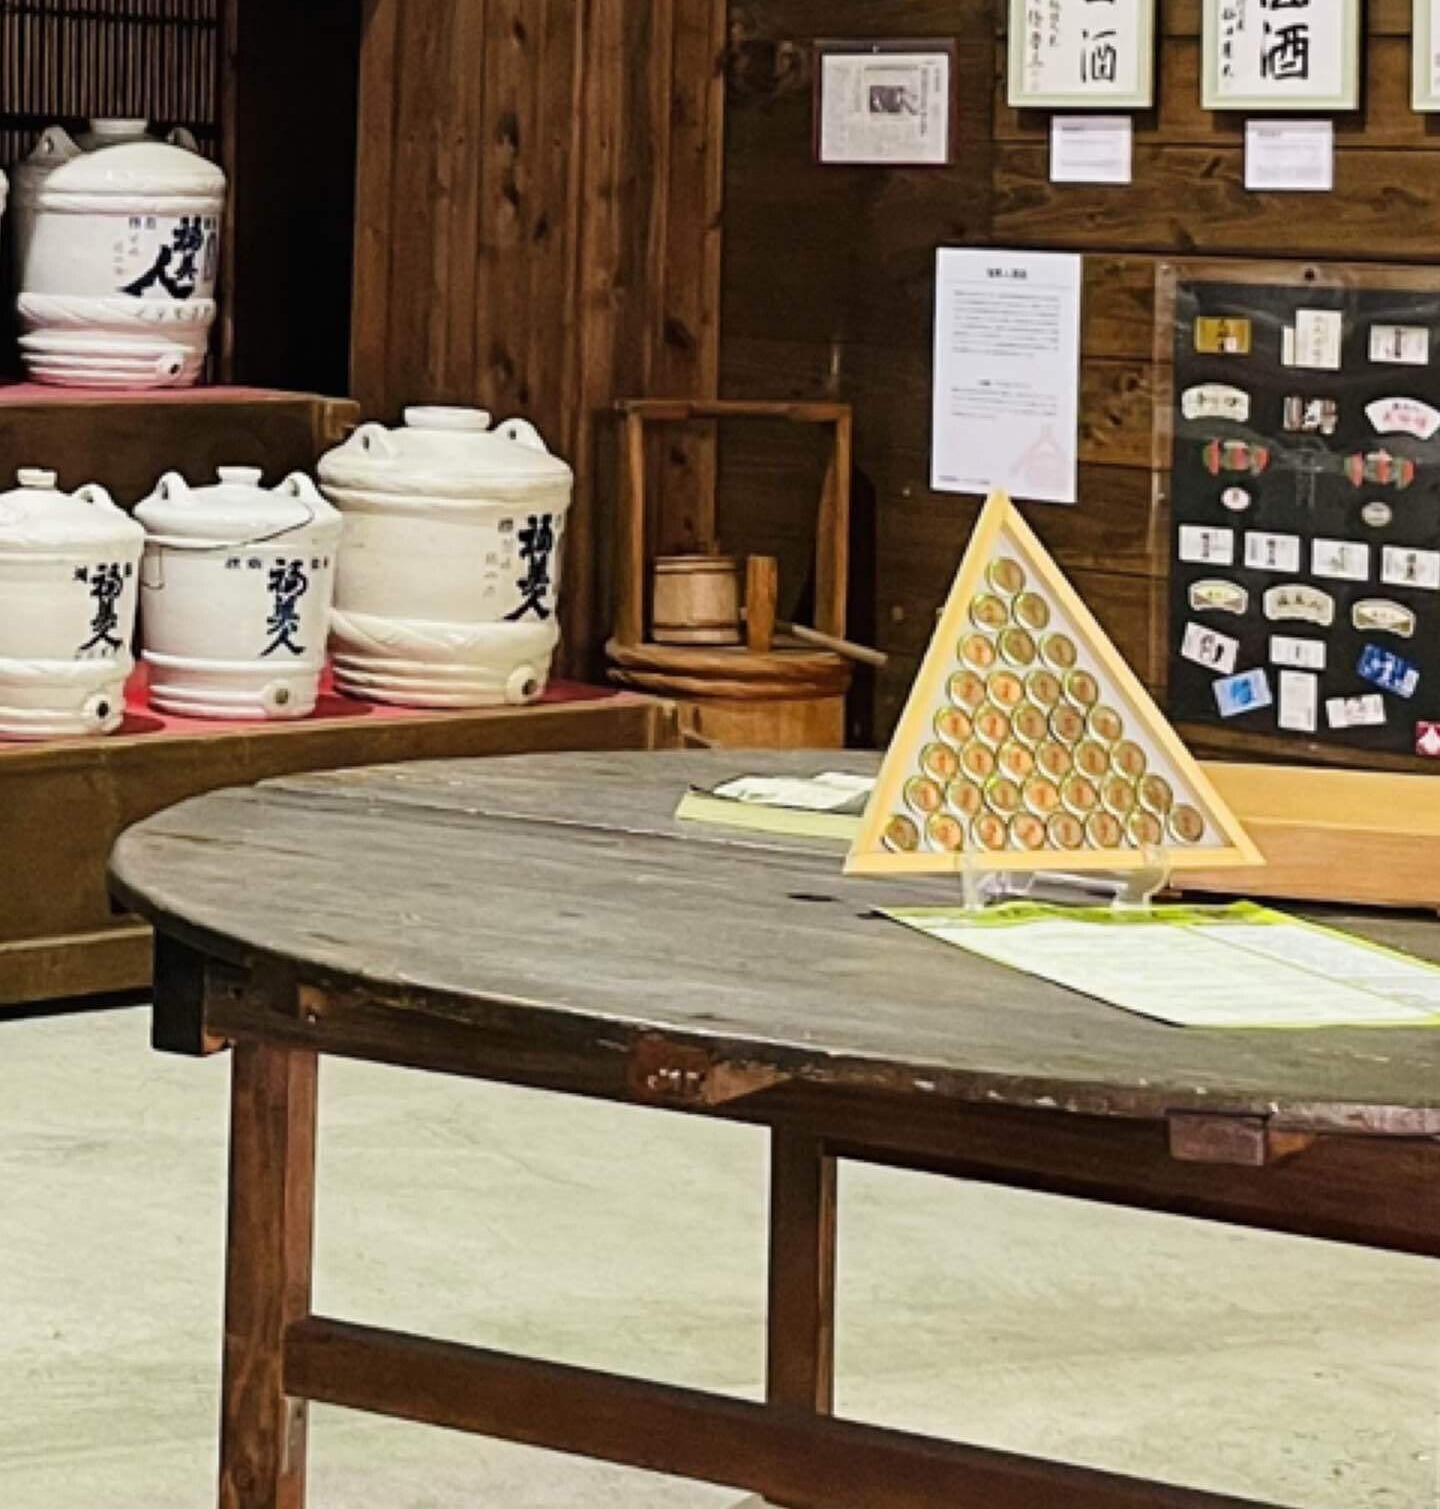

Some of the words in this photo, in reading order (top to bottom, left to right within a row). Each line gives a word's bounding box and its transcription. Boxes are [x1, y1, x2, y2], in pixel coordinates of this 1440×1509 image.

[124, 217, 203, 299] 福美人
[80, 562, 124, 652] 福美人
[259, 558, 309, 657] 福美人
[503, 514, 553, 621] 福美人
